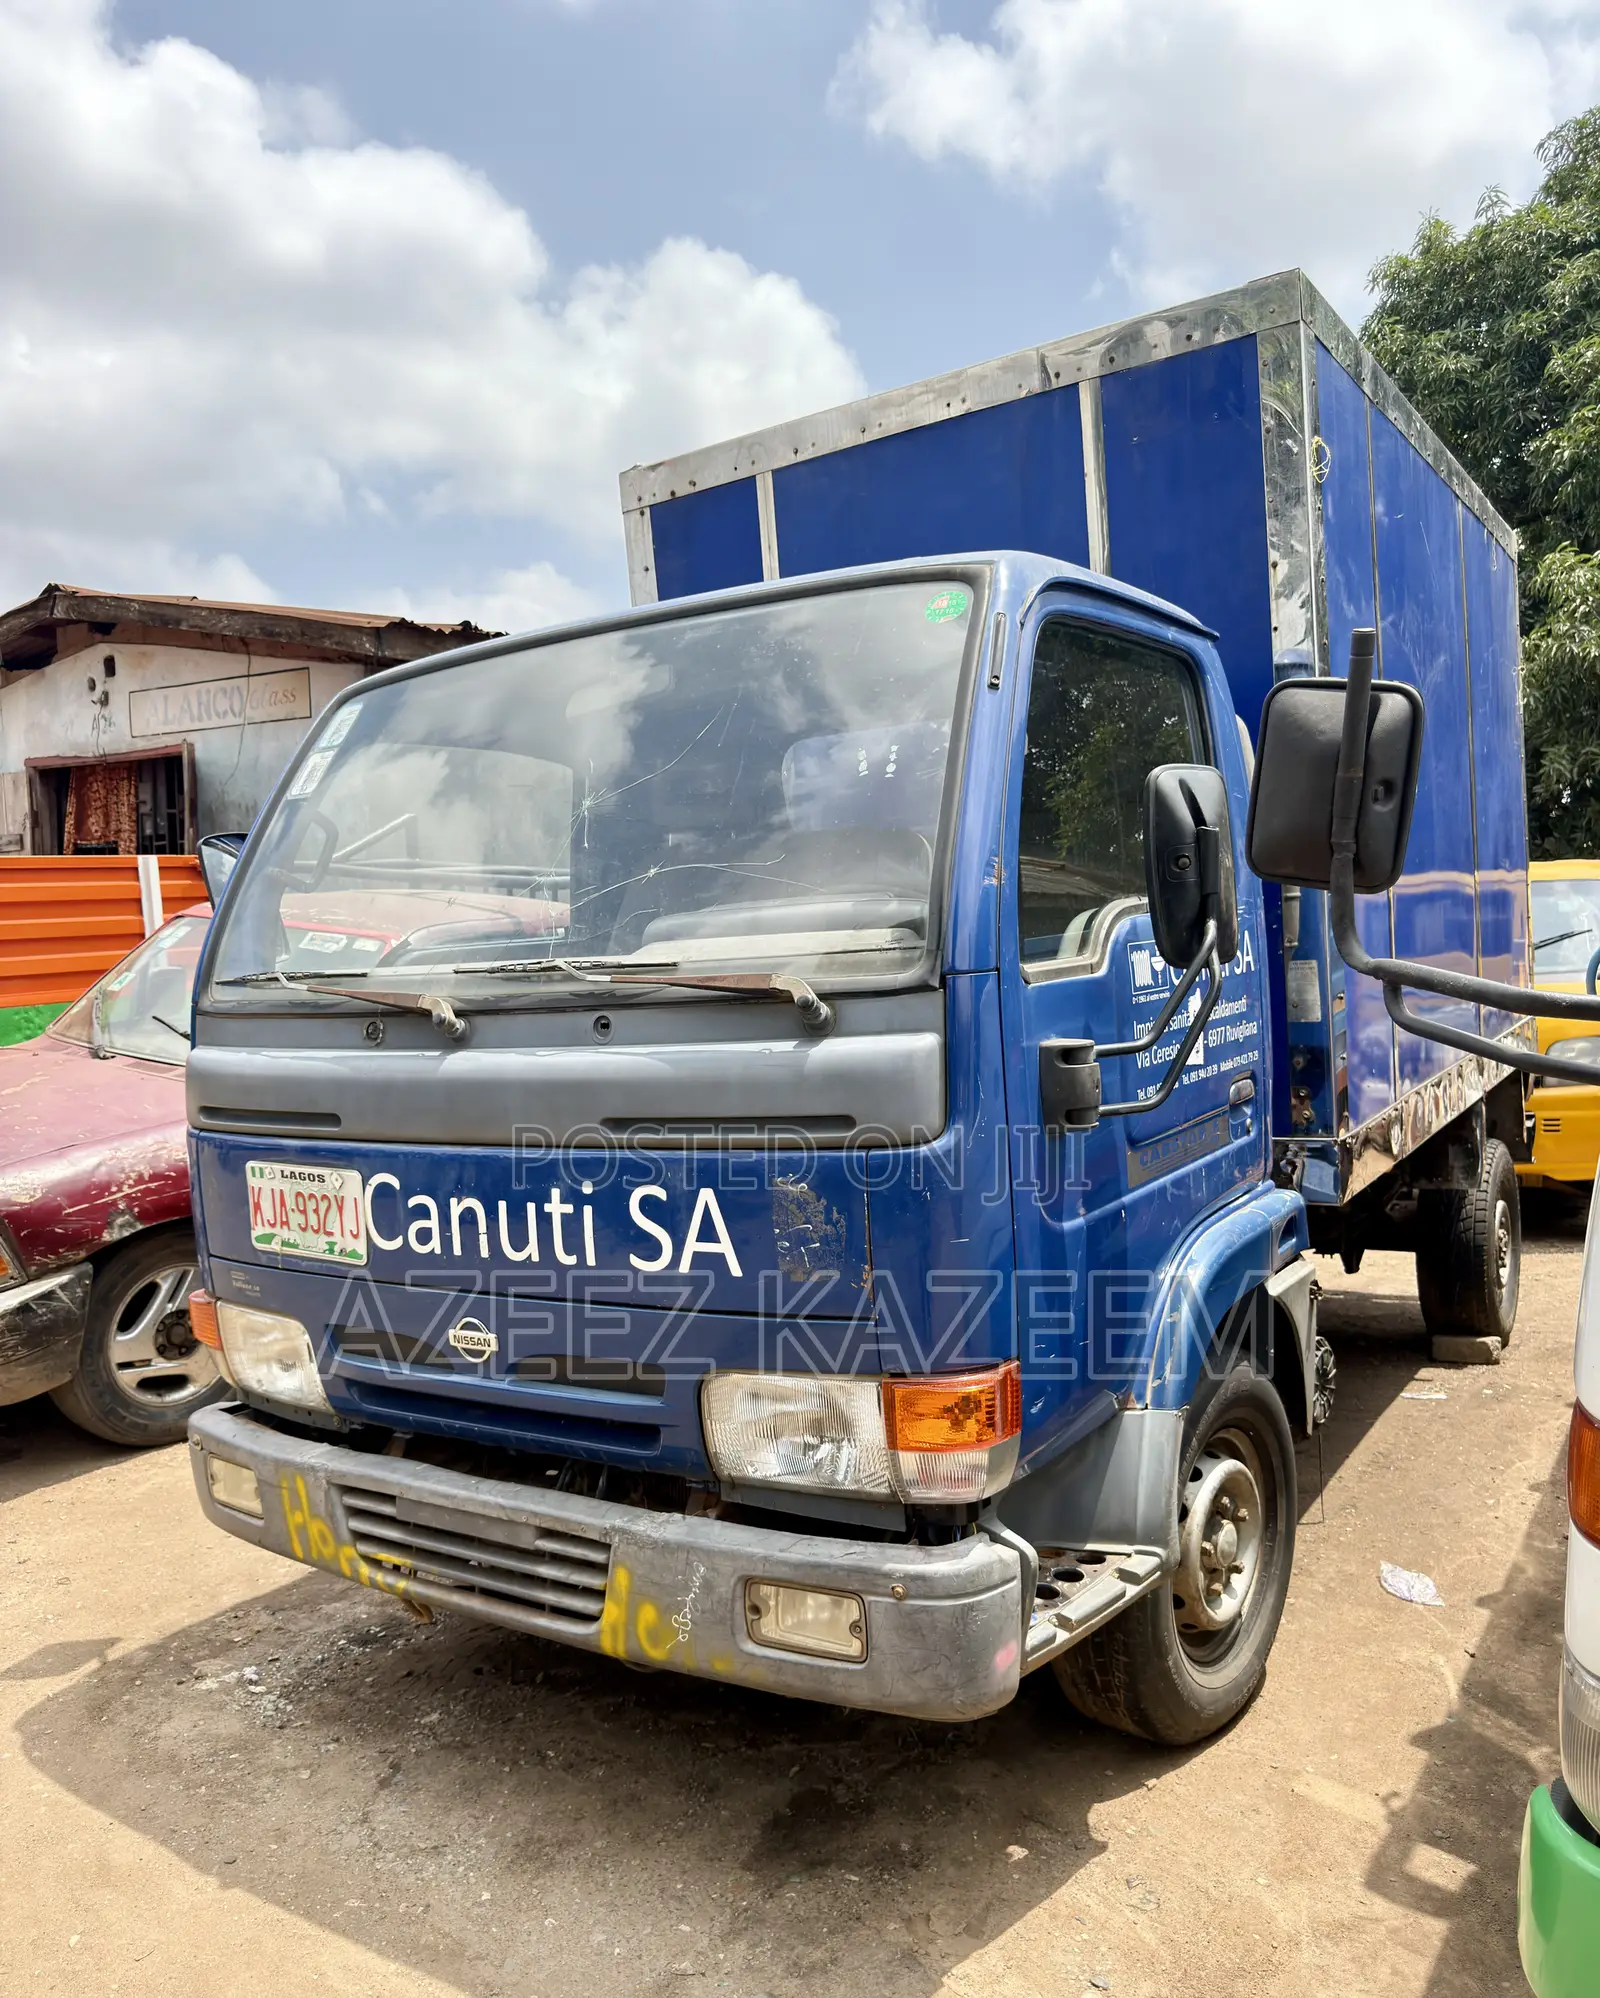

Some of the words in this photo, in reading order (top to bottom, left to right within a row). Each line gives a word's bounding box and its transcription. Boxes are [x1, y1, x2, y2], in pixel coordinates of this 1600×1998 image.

[1207, 994, 1247, 1021] scaldamenti
[1136, 1051, 1150, 1069] Via
[1208, 1027, 1225, 1047] 6977
[280, 1169, 326, 1184] LAGOS
[364, 1172, 596, 1267] Canuti
[629, 1184, 743, 1277] SA
[453, 1334, 491, 1348] NISSAN
